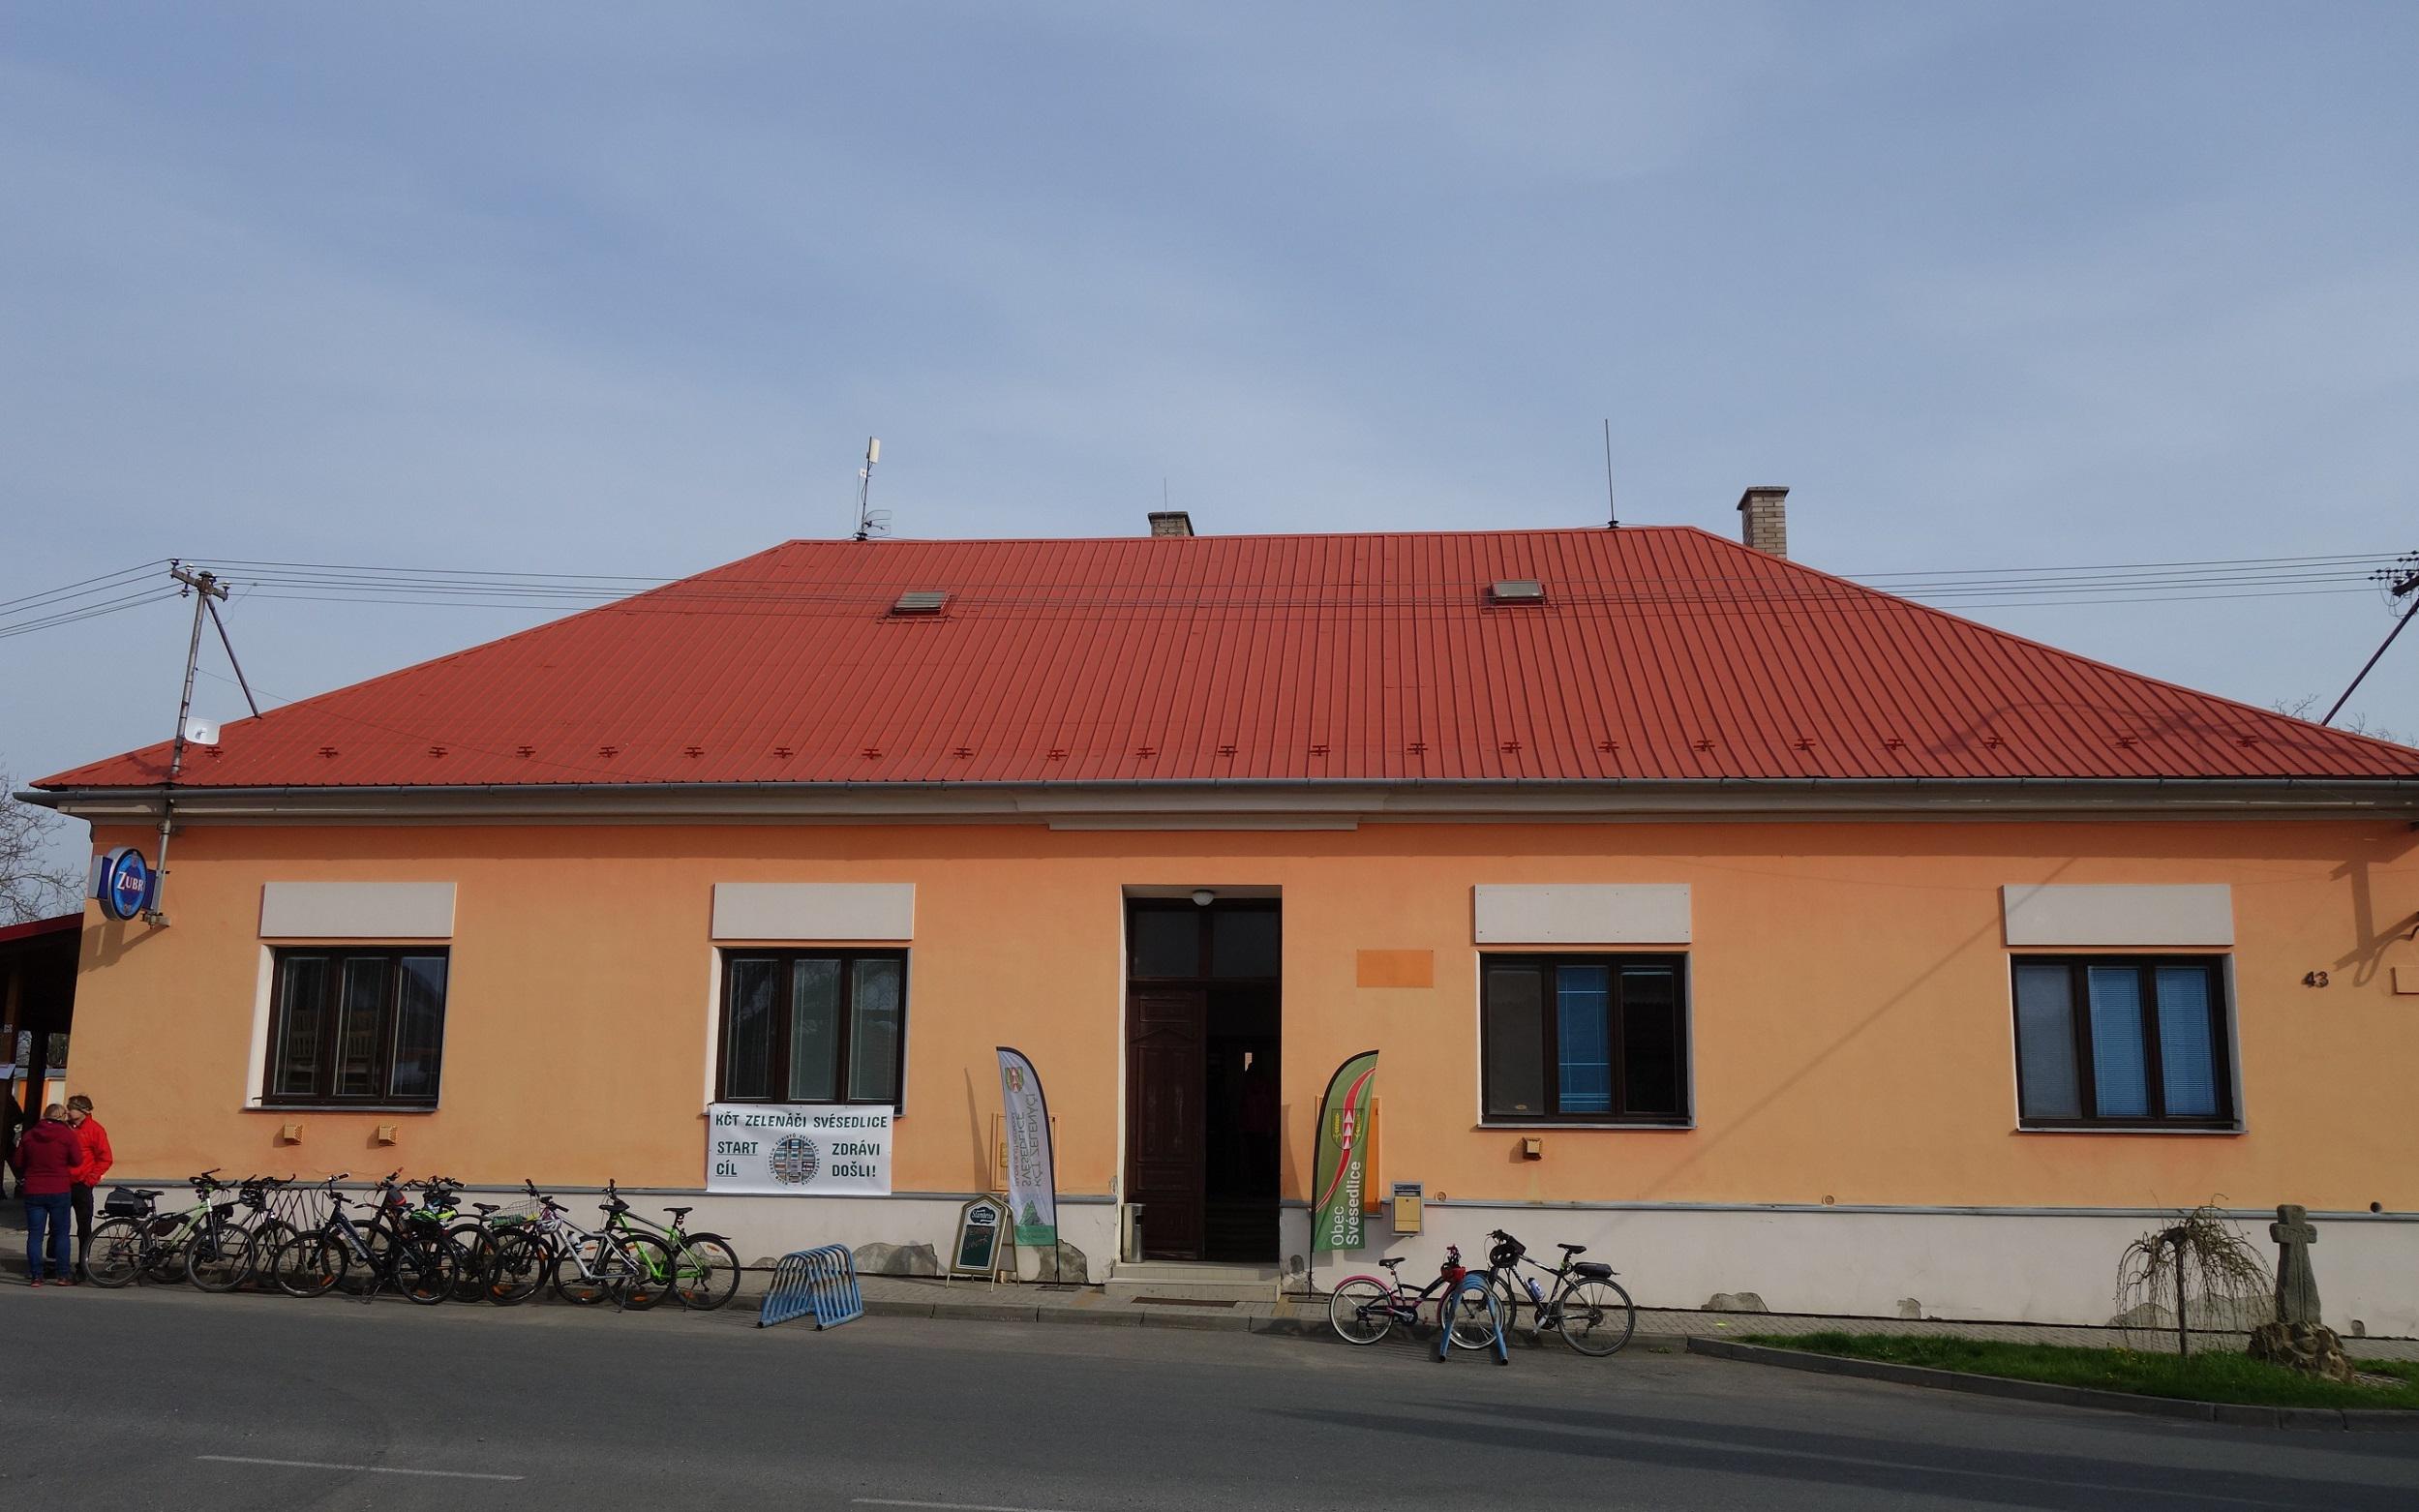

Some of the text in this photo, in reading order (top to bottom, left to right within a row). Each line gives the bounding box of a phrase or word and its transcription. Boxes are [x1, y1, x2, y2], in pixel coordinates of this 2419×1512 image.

[116, 871, 144, 891] ZUBR
[2301, 971, 2329, 988] 43
[715, 1111, 888, 1129] KČT ZELENÁČI SVÉSEDLICE
[717, 1141, 759, 1154] START
[832, 1139, 880, 1156] ZDRÁVI
[716, 1160, 738, 1175] CÍL
[832, 1162, 876, 1177] DOŠLI!
[1346, 1162, 1361, 1245] Svésedlice
[1330, 1206, 1345, 1246] Obec
